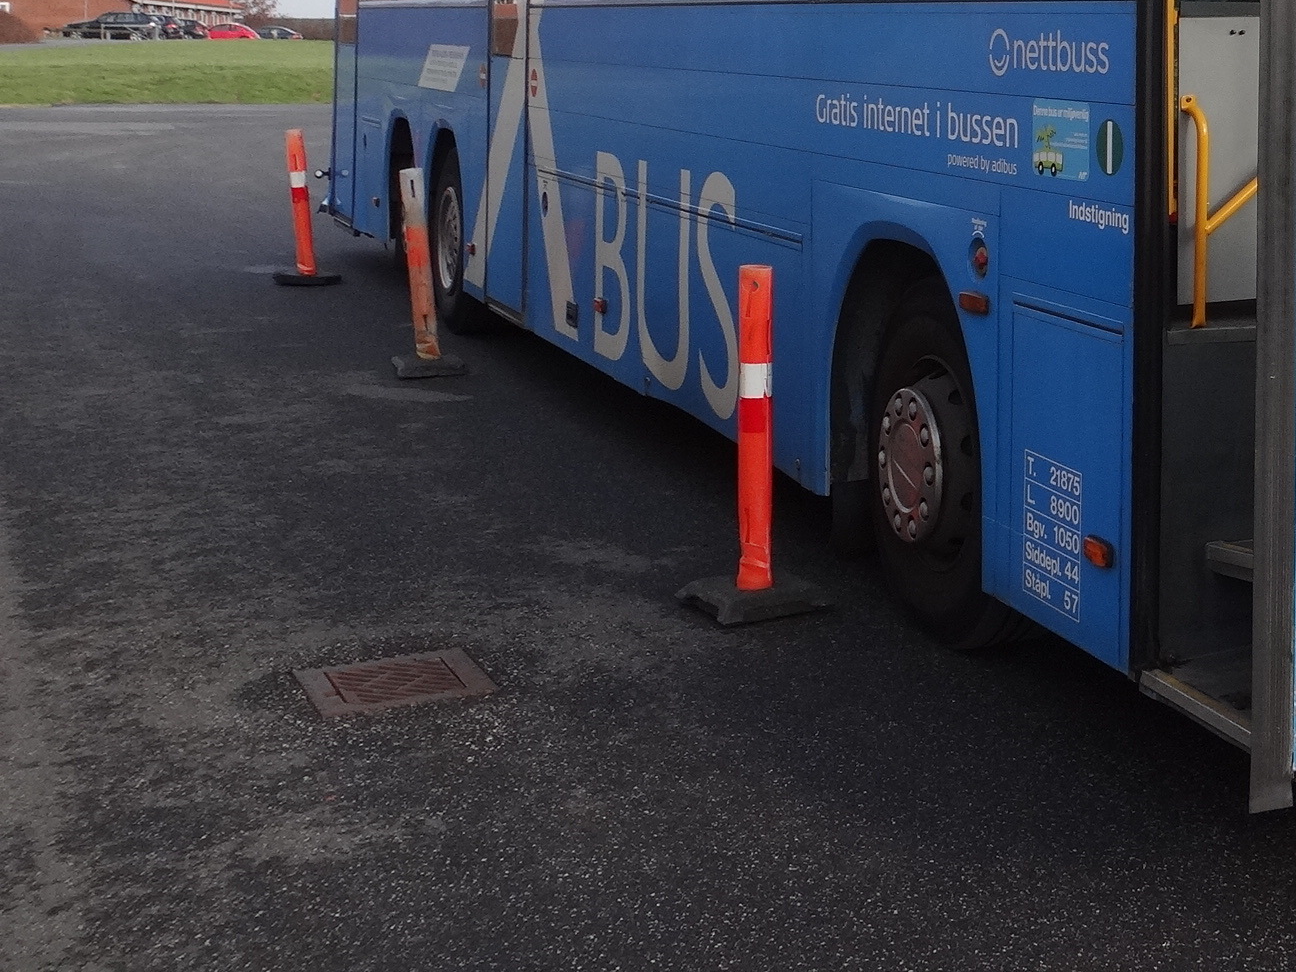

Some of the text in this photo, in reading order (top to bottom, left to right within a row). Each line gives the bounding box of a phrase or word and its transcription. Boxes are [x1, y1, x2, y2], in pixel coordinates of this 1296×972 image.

[1013, 30, 1110, 74] nettbuss
[816, 93, 858, 129] Gratis
[863, 95, 930, 137] internet
[947, 102, 1018, 148] bussen
[947, 154, 979, 168] powered
[980, 155, 991, 174] by
[1068, 200, 1130, 234] Indstigning
[594, 150, 739, 421] BUS
[1027, 457, 1080, 495] T. 21875
[1050, 495, 1080, 525] 8900
[1026, 513, 1080, 554] Bgv. 1050
[1025, 542, 1080, 584] Siddepl. 44
[1063, 590, 1079, 614] 57
